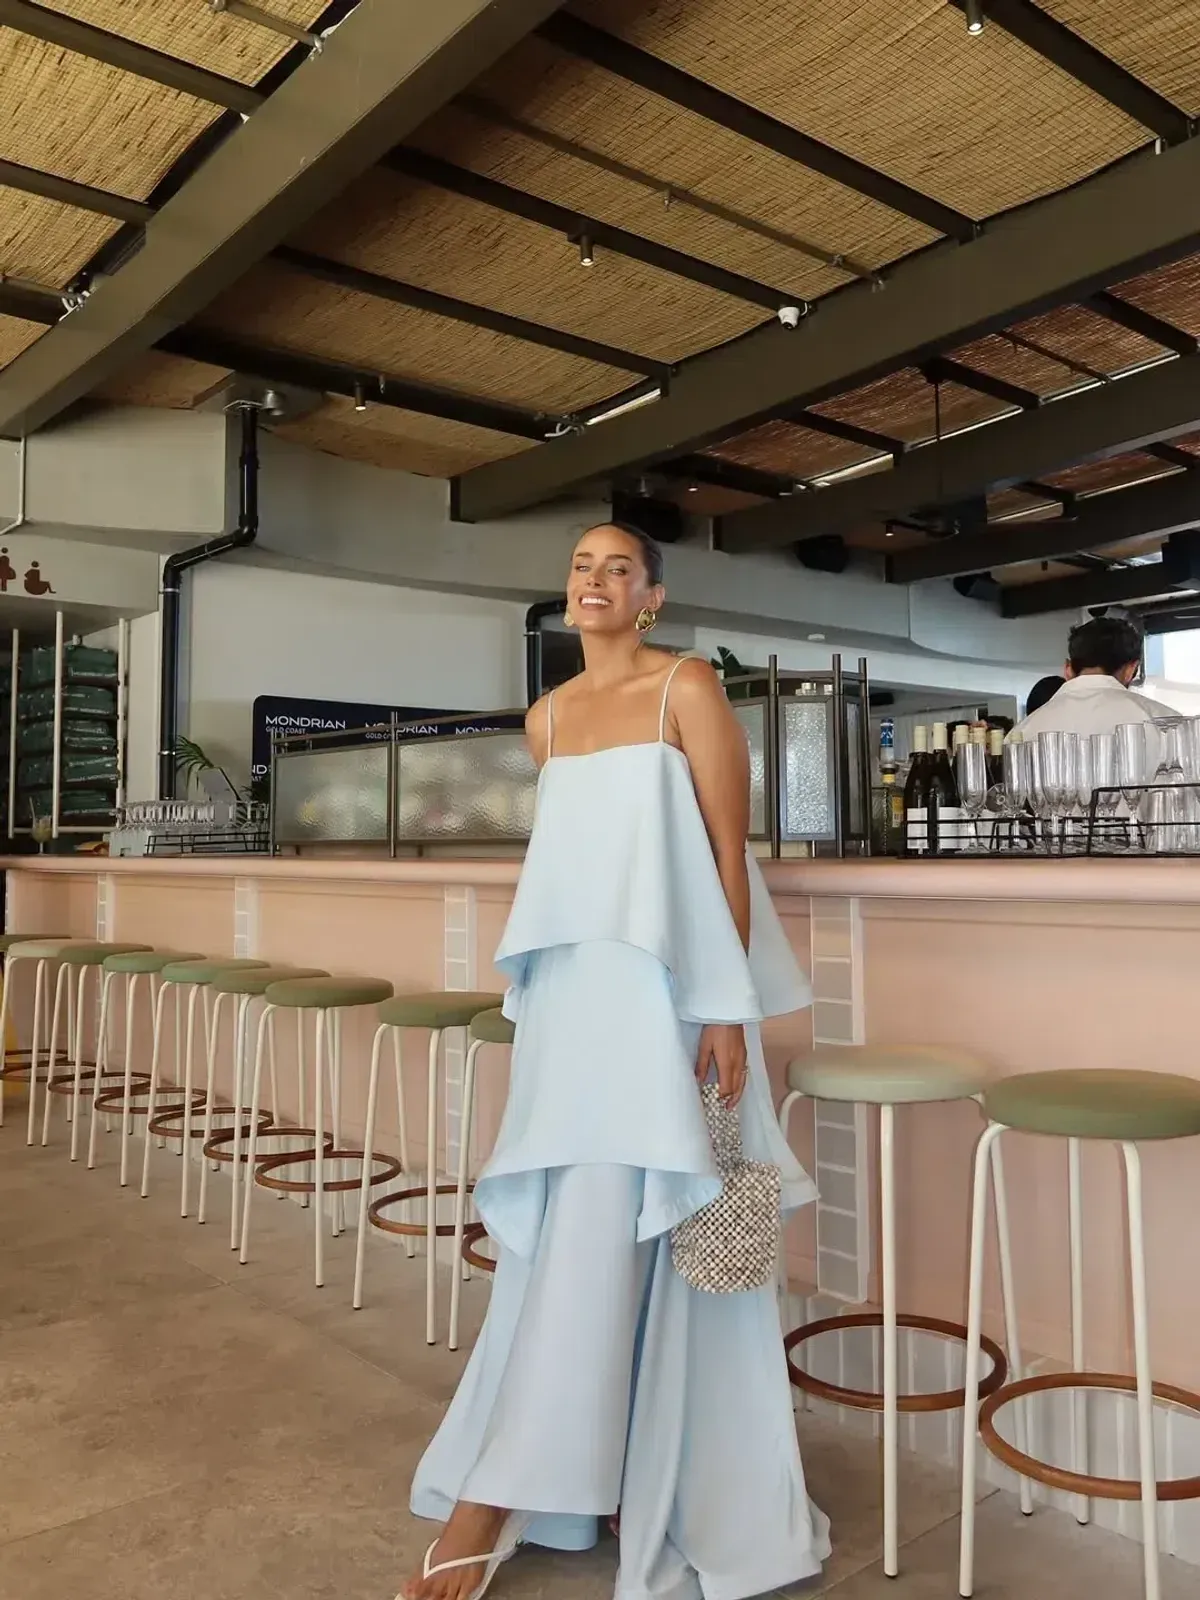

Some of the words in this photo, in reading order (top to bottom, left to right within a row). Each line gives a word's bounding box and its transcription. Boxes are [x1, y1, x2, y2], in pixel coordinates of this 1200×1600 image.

[265, 714, 346, 730] MONDRIAN
[284, 727, 306, 735] COAST
[365, 732, 383, 740] GOLD
